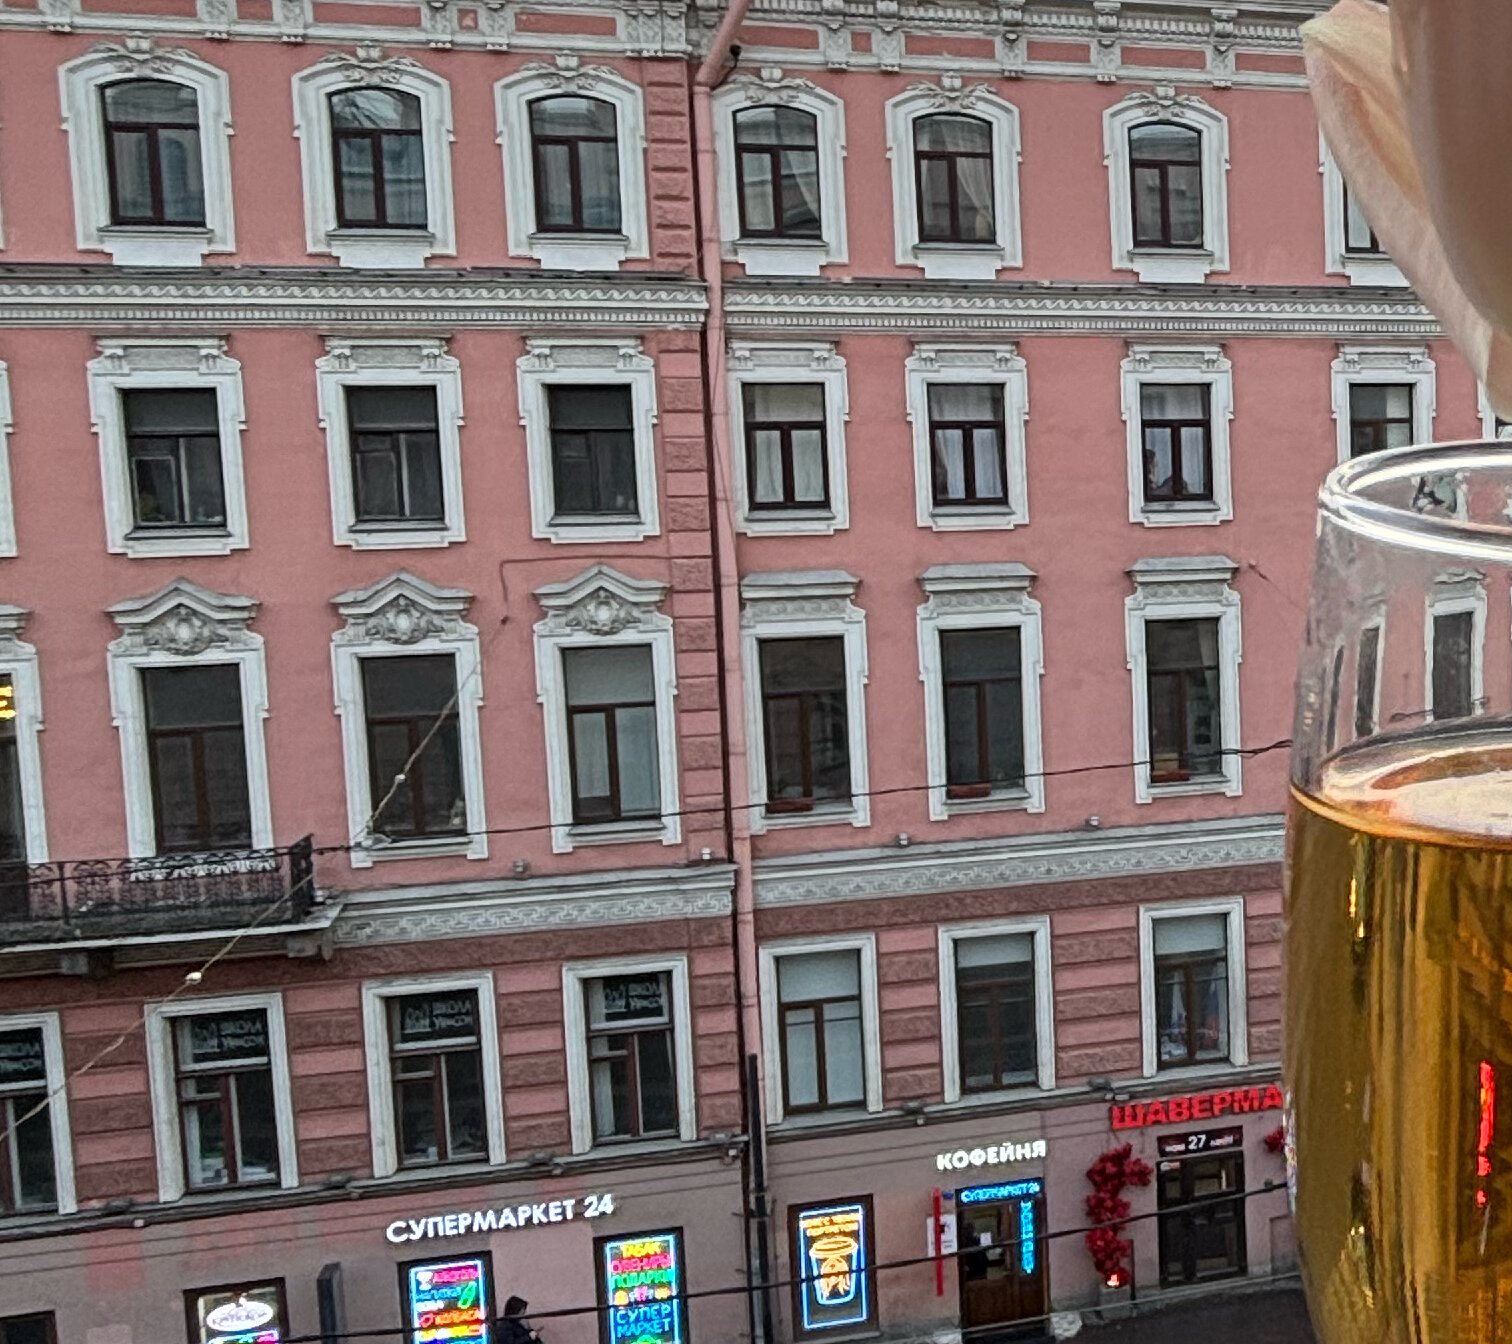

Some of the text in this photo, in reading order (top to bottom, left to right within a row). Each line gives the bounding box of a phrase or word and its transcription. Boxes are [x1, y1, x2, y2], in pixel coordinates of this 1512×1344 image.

[1111, 1082, 1283, 1130] ШАВЕРМА
[936, 1139, 1047, 1171] КОФЕЙНЯ
[1187, 1134, 1206, 1150] 27
[385, 1193, 614, 1244] СУПЕРМАРКЕТ 24
[616, 1304, 671, 1324] СУПЕР
[616, 1318, 671, 1338] МАРКЕТ
